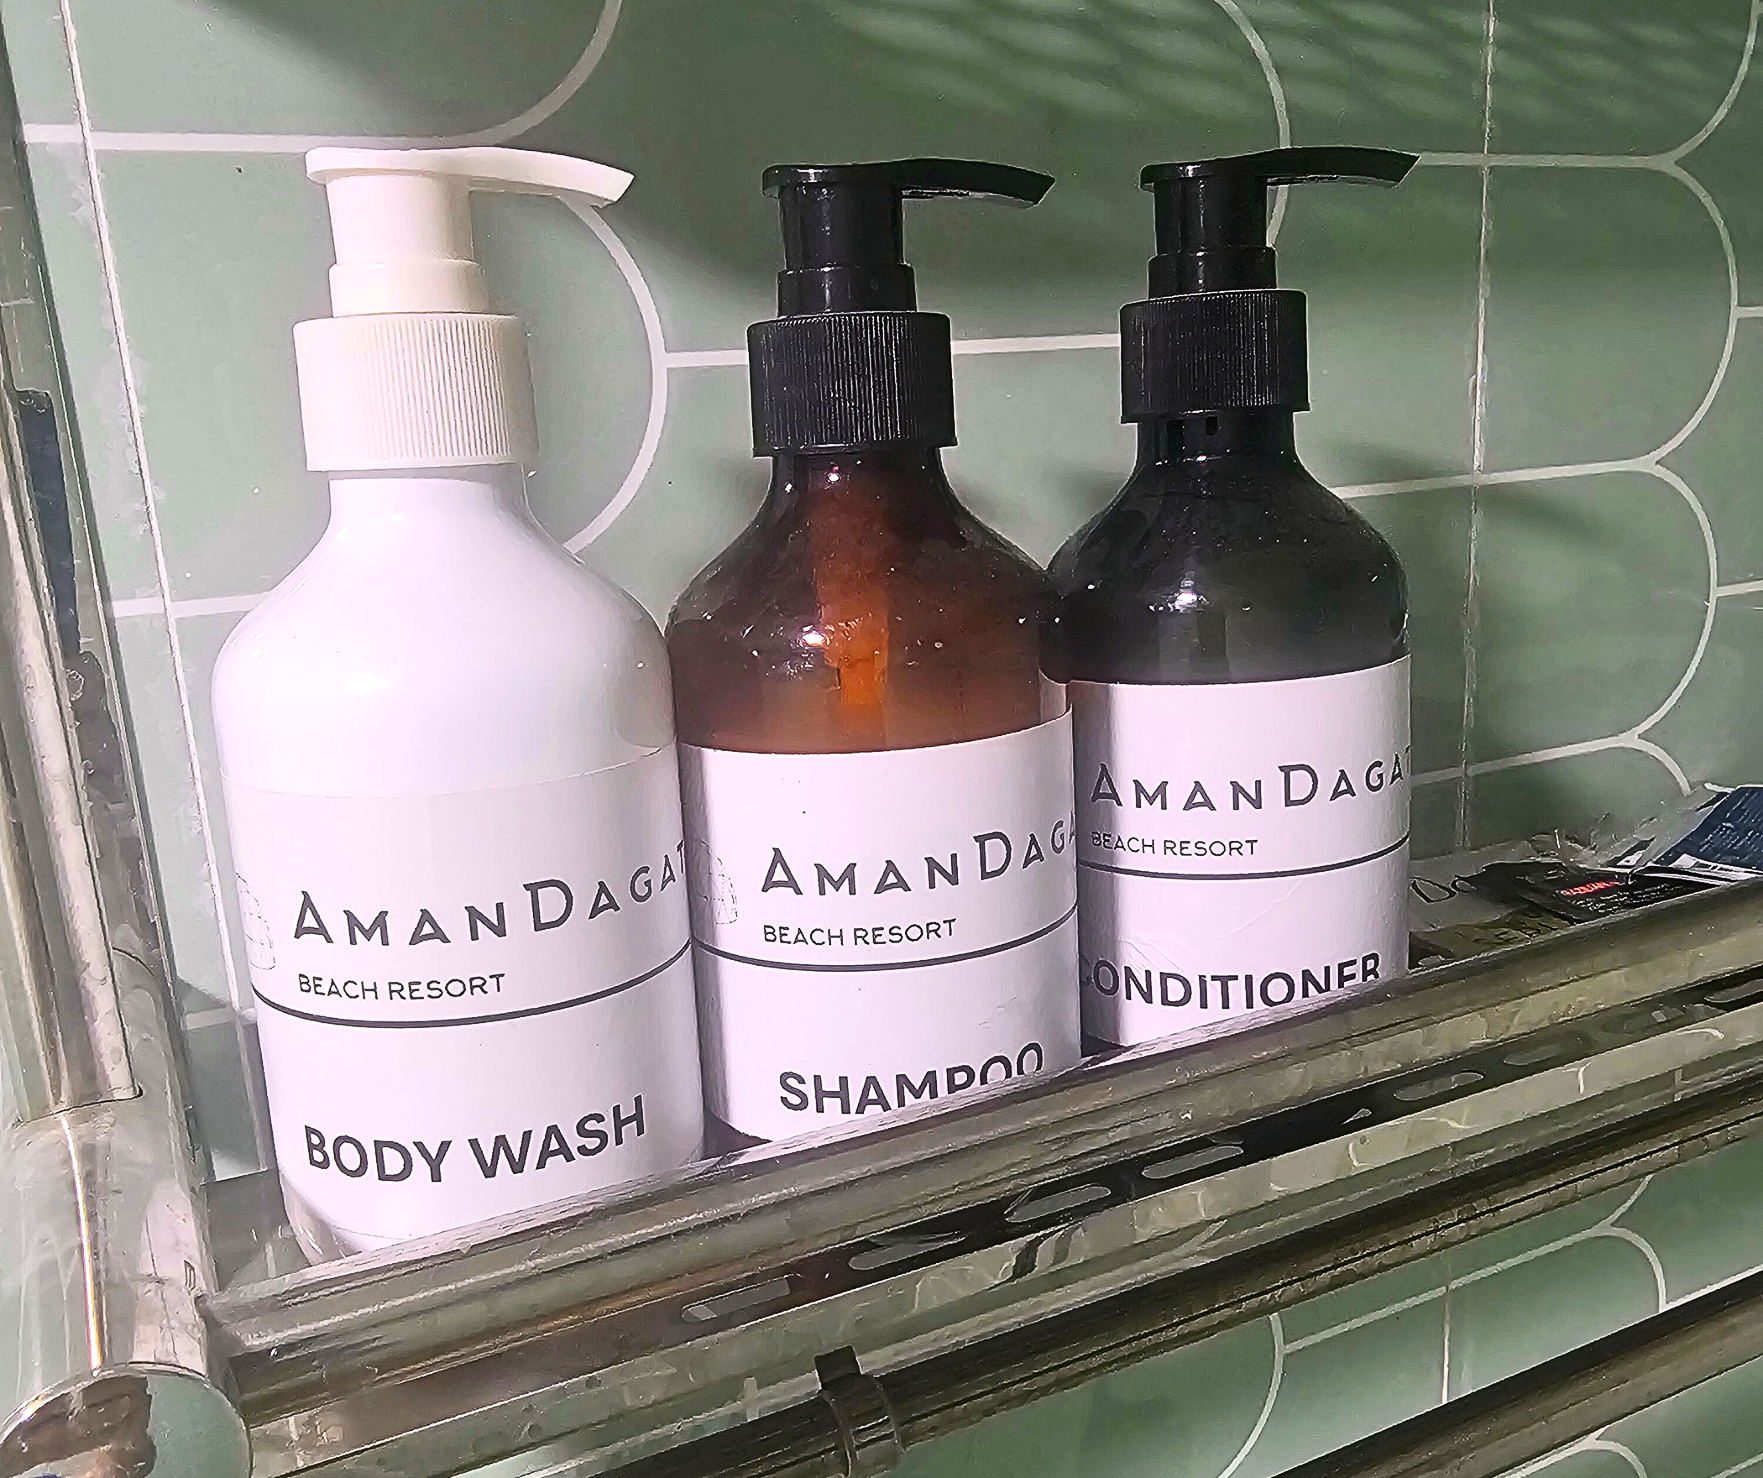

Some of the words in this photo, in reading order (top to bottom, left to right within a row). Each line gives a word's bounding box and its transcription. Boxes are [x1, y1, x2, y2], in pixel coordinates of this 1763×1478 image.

[1091, 831, 1156, 855] BEACH
[1163, 839, 1259, 857] RESORT
[763, 924, 846, 946] BEACH
[853, 917, 957, 947] RESORT
[298, 973, 379, 1001] BEACH
[387, 973, 506, 1001] RESORT
[1081, 952, 1380, 1010] ONDITIONER
[779, 1042, 1044, 1115] SHAMPOO
[304, 1124, 453, 1183] BODY
[467, 1094, 645, 1179] WASH
